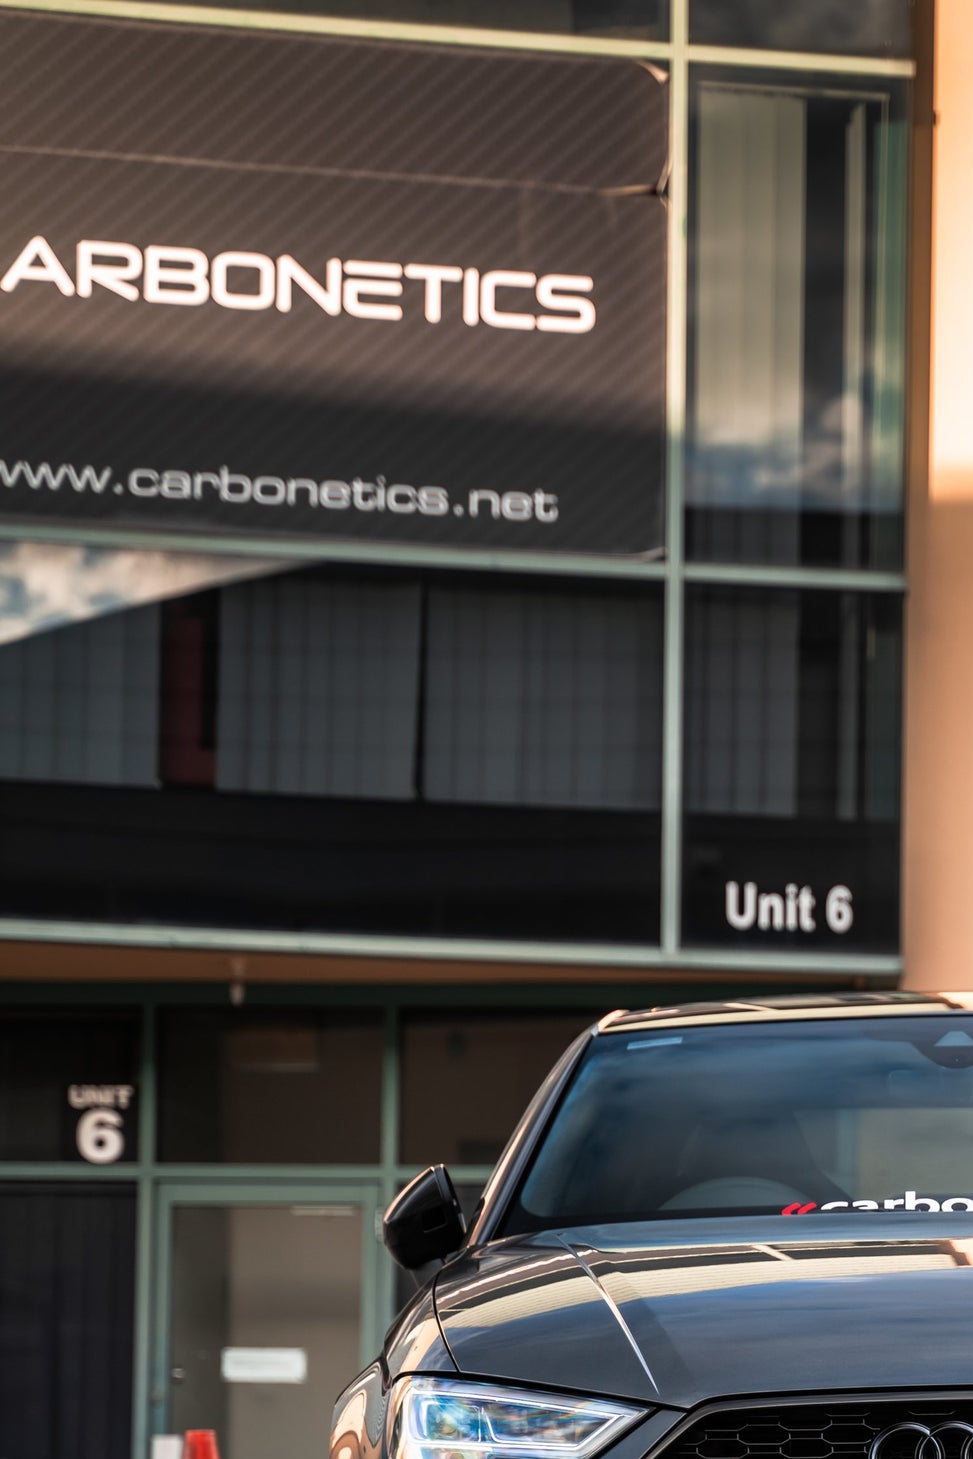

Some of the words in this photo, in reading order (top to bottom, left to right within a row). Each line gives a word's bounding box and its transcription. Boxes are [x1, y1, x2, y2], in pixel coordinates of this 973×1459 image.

[0, 235, 597, 335] ARBONETICS
[725, 881, 816, 932] Unit
[826, 884, 854, 934] 6
[68, 1083, 134, 1109] UNIT
[76, 1107, 125, 1165] 6
